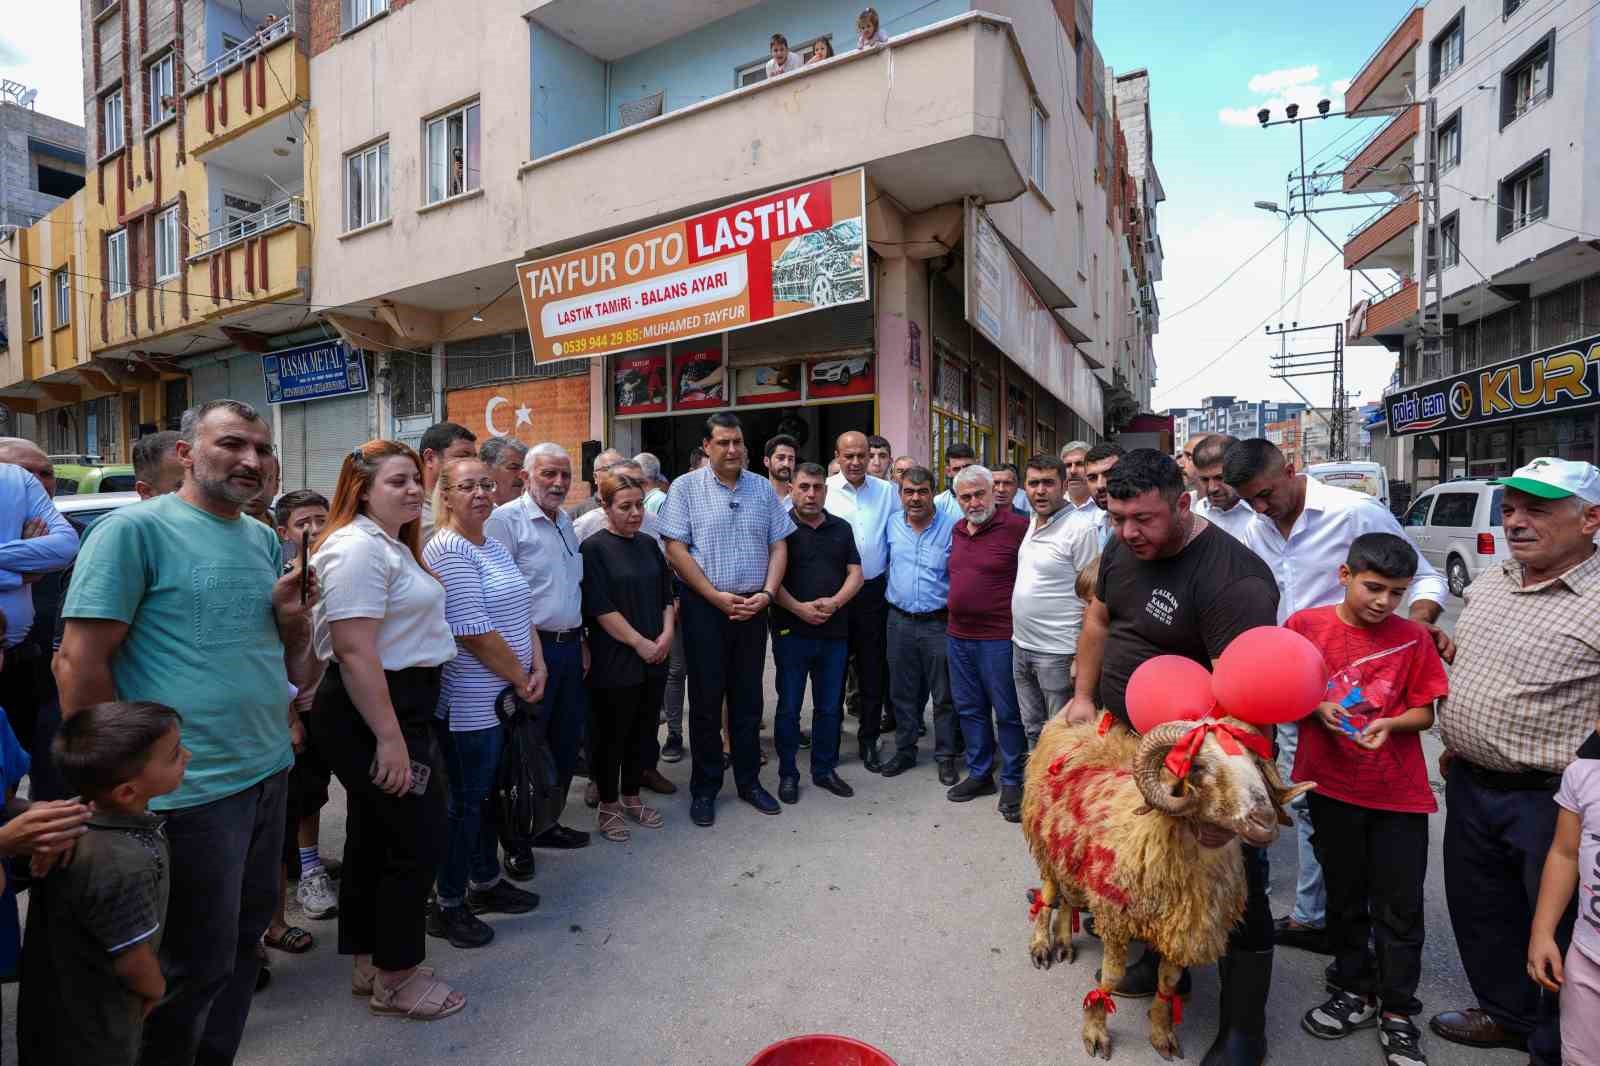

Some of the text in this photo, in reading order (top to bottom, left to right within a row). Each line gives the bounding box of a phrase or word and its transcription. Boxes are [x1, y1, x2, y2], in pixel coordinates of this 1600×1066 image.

[526, 252, 616, 299] TAYFUR
[624, 232, 683, 276] OTO
[641, 282, 688, 306] BALANS
[691, 272, 728, 294] AYARI
[563, 337, 587, 354] 0539
[589, 335, 608, 350] 944
[703, 305, 745, 325] TAYFUR
[309, 347, 343, 372] METAL
[1392, 391, 1420, 430] polat
[1421, 393, 1446, 418] cam
